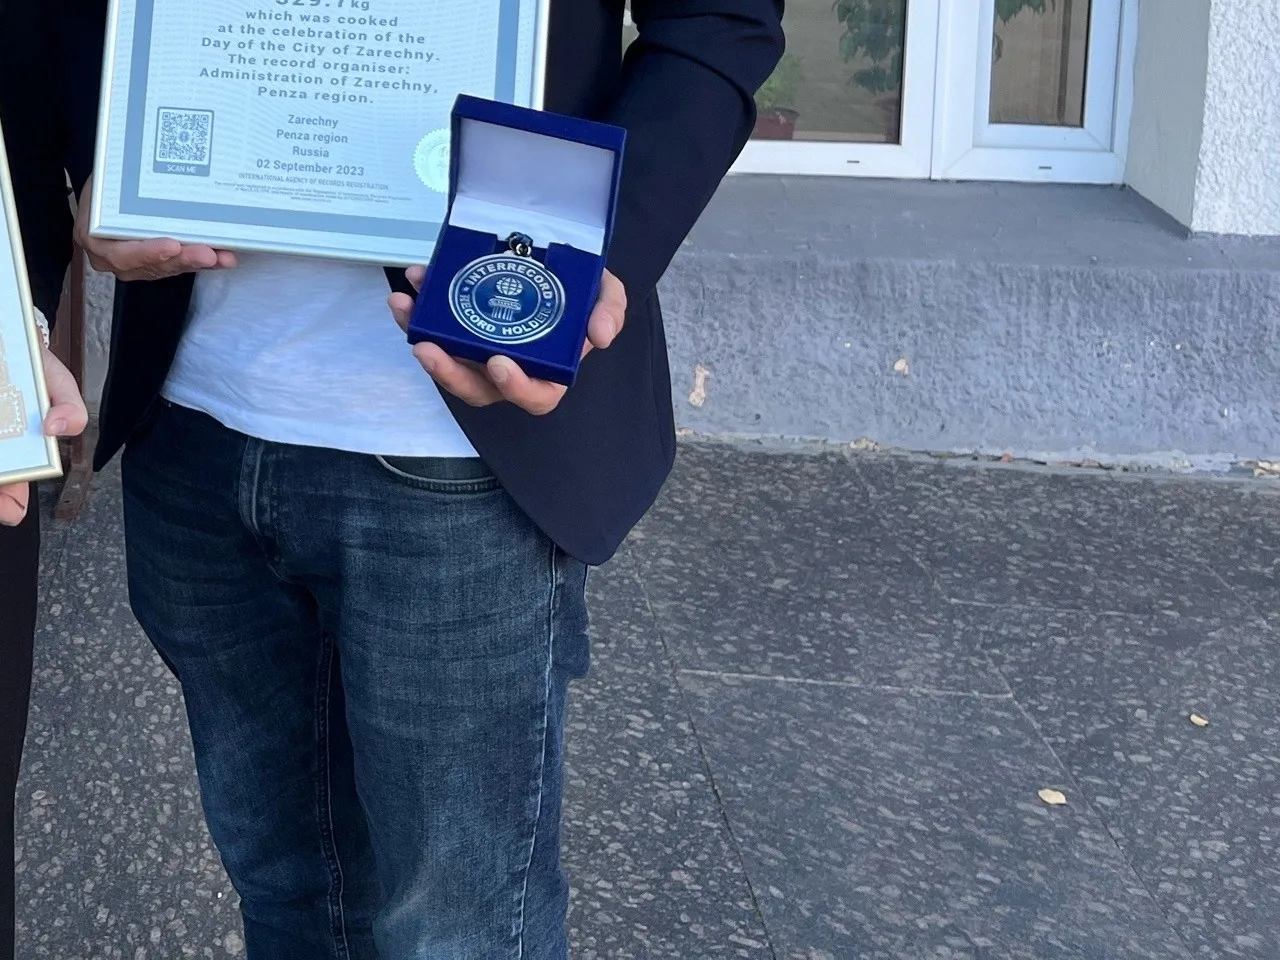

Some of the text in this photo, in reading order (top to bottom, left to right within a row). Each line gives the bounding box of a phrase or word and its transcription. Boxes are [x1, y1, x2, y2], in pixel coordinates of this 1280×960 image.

[246, 10, 398, 27] which was cooked
[218, 24, 425, 44] at the celebration of the
[202, 37, 440, 63] Day of the City of Zarechny.
[228, 54, 411, 75] The record organiser:
[199, 67, 438, 94] Administration of Zarechny,
[258, 86, 374, 104] Penza region.
[288, 114, 339, 129] Zarechny
[276, 128, 348, 146] Penza region
[292, 146, 330, 158] Russia
[167, 164, 185, 173] SCAN
[256, 158, 365, 177] 02 September 2023
[464, 262, 553, 300] INTERRECORD
[459, 294, 496, 333] RECORD
